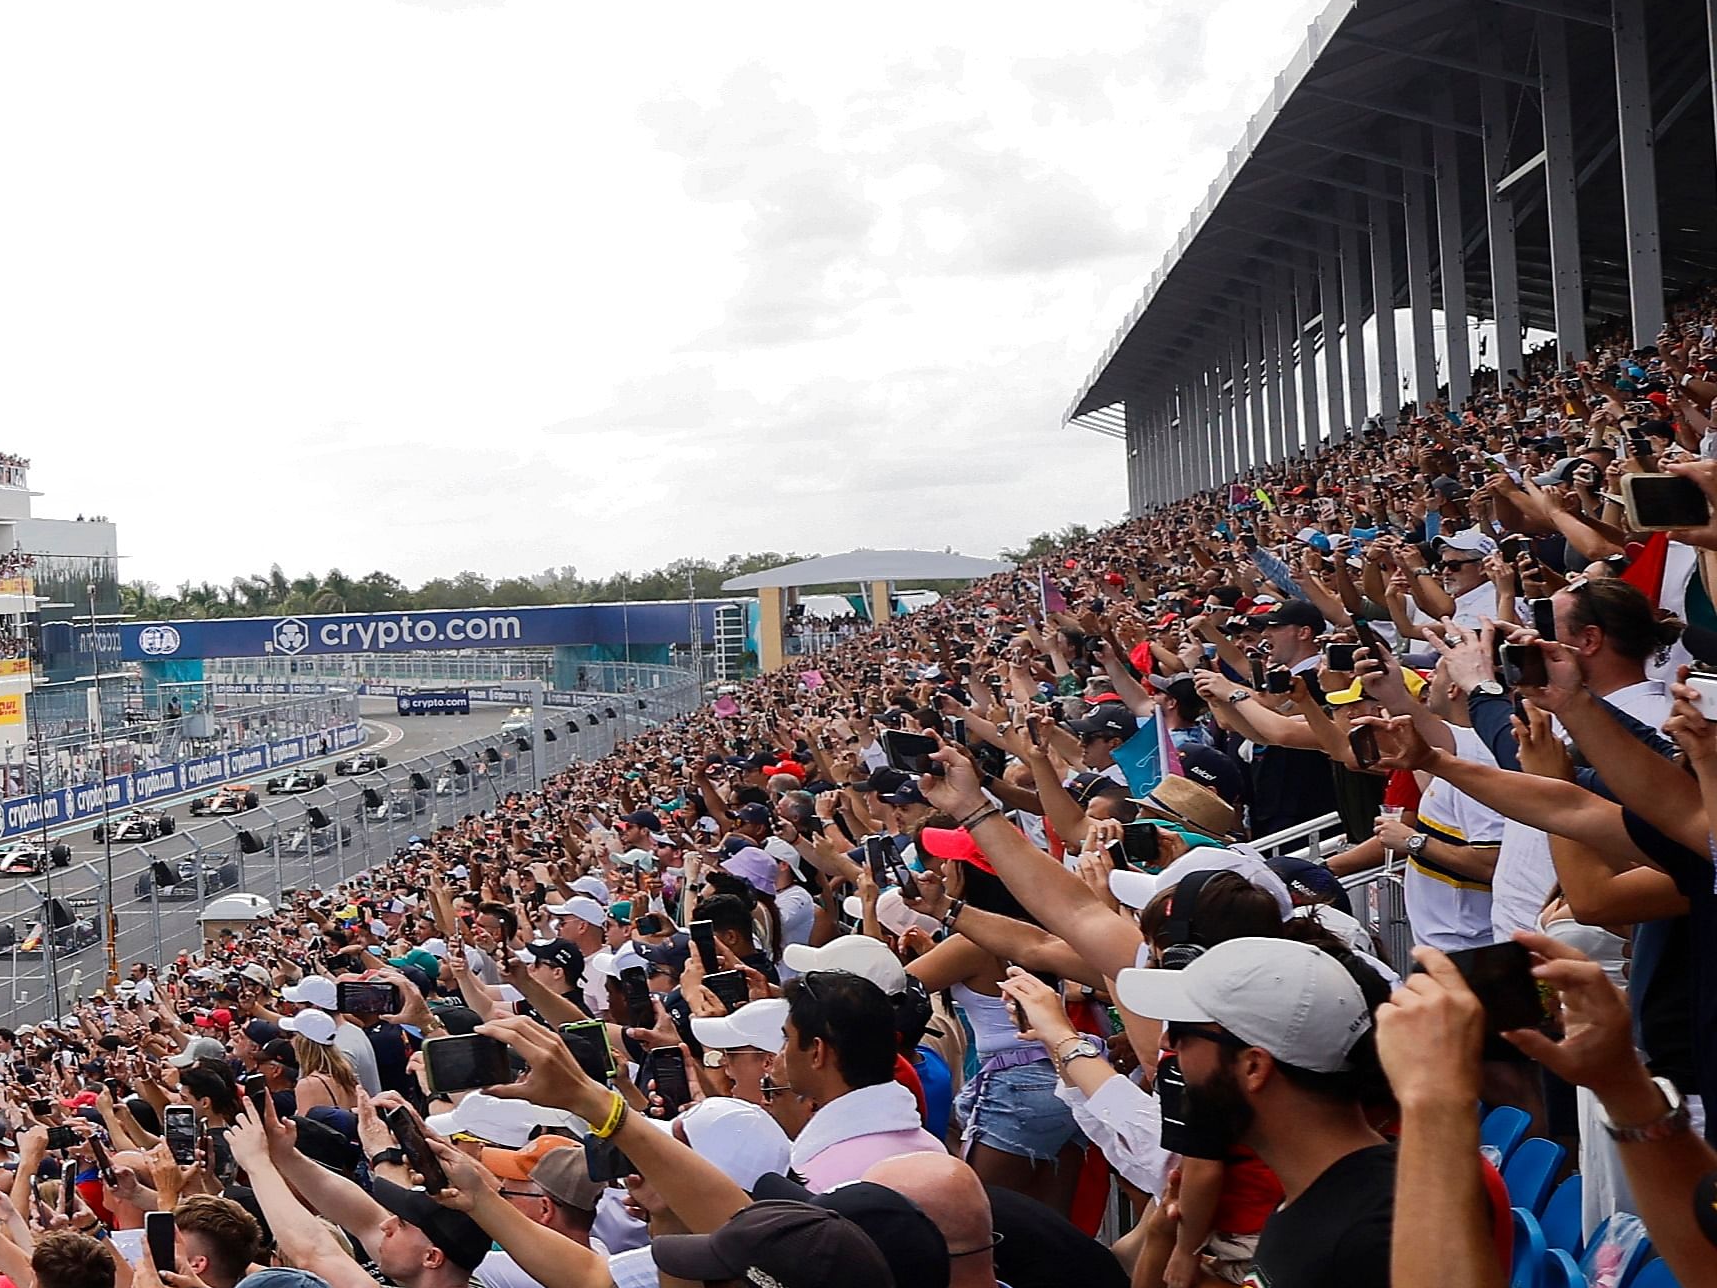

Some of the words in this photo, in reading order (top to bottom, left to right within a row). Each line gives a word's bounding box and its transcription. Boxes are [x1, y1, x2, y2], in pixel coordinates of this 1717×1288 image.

[144, 633, 177, 650] FIA
[320, 614, 521, 650] crypto.com
[412, 697, 467, 710] crypto.com
[7, 797, 59, 828] crypto.com
